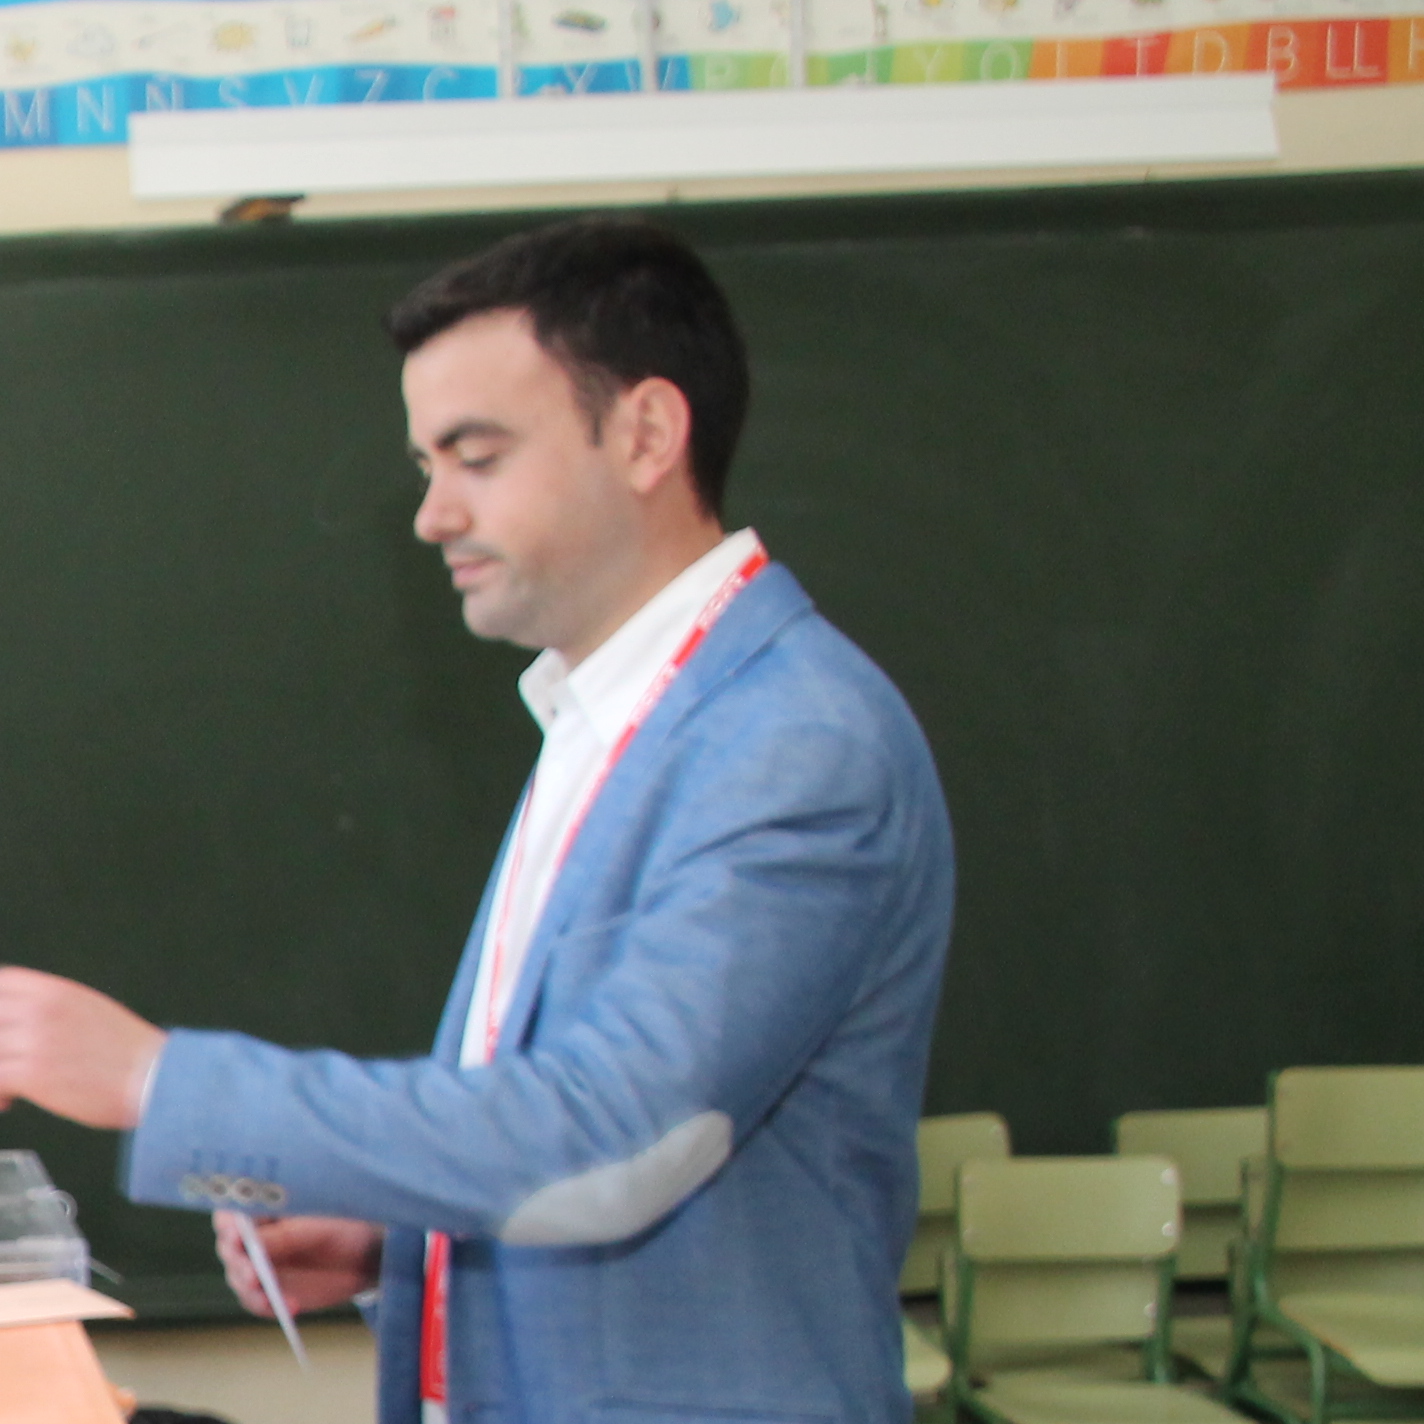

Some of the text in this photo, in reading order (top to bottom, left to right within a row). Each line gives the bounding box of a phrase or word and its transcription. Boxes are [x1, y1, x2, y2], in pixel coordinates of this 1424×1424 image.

[3, 87, 51, 139] M
[75, 83, 115, 134] N
[1266, 24, 1300, 84] B
